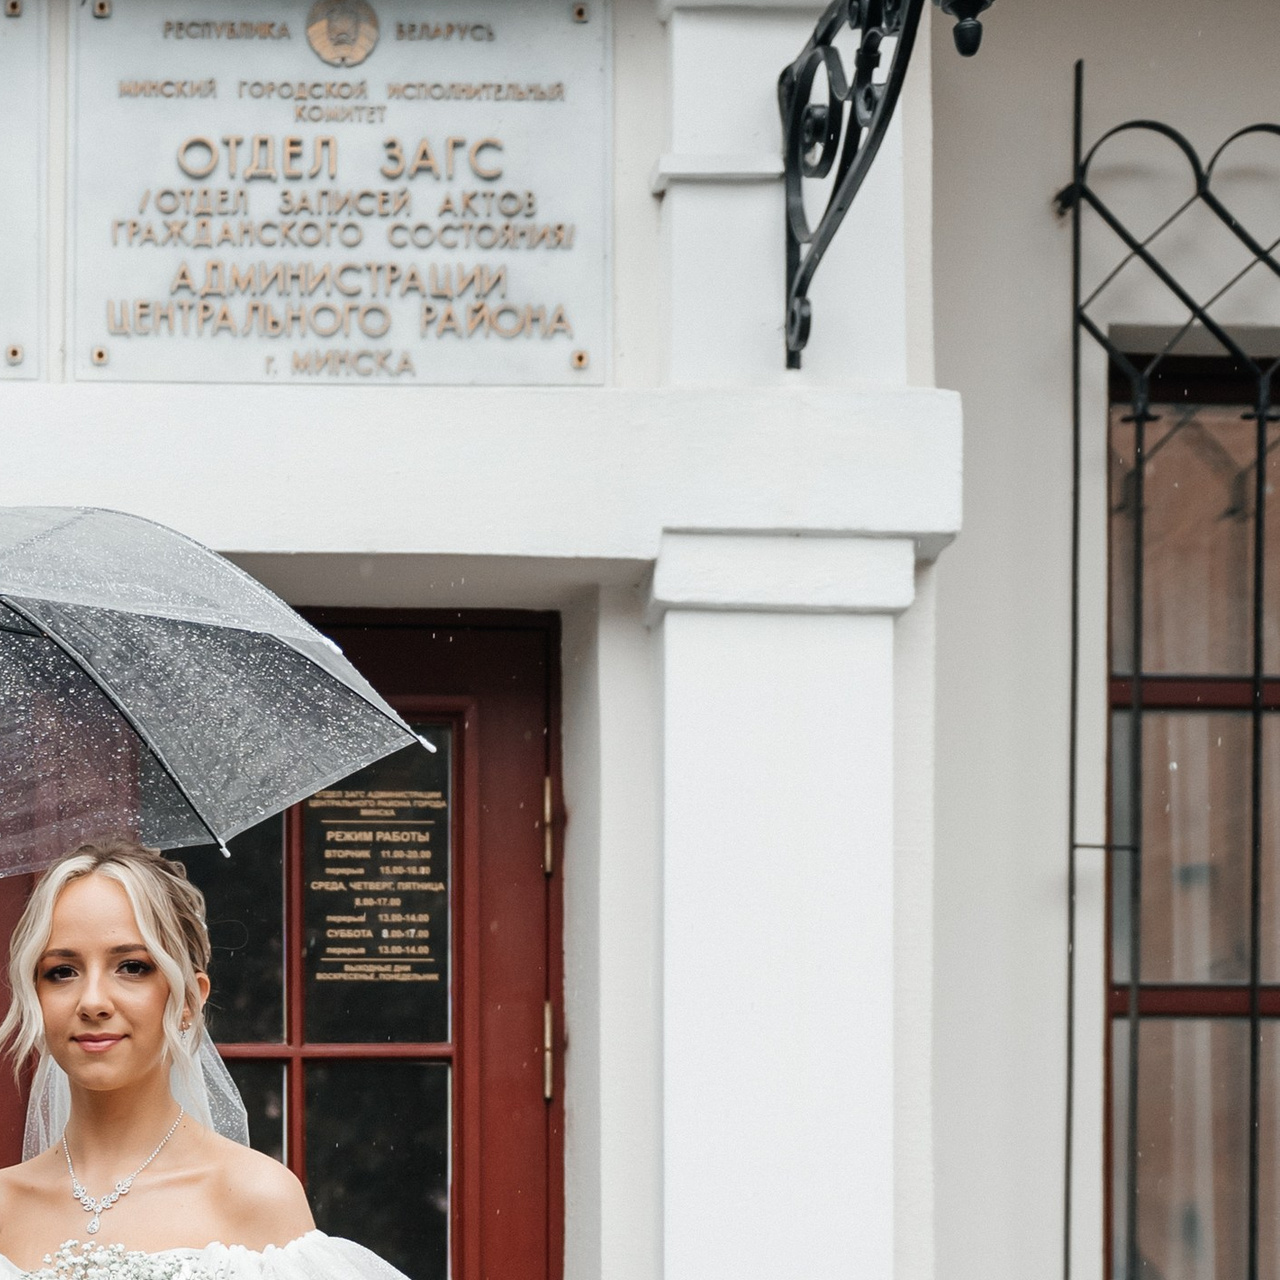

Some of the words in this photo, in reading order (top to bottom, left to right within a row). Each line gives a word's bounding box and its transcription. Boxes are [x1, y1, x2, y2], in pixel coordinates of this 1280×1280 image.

[163, 20, 291, 40] РЕСПУБЛИКА
[396, 22, 495, 42] БЕЛАРУСЬ
[119, 78, 216, 99] МИНСКИЙ
[238, 79, 368, 100] ГОРОДСКОЙ
[387, 81, 565, 102] ИСПОЛНИТЕЛЬНЫЙ
[294, 104, 387, 124] КОМИТЕТ
[177, 135, 338, 183] ОТДЕЛ
[379, 137, 505, 183] ЗАГС
[278, 187, 412, 218] ЗАПИСЕЙ
[438, 190, 539, 218] АКТОВ
[111, 219, 363, 249] ГРАЖДАНСКОГО
[169, 261, 508, 300] АДМИНИСТРАЦИИ
[106, 299, 392, 338] ЦЕНТРАЛЬНОГО
[420, 300, 574, 339] РАЙОНА
[291, 349, 416, 377] МИНСКА
[326, 831, 373, 842] РЕЖИМ
[376, 831, 430, 842] РАБОТЫ
[324, 850, 371, 859] ВТОРНИК
[397, 882, 446, 892] ПЯТНИЦА
[326, 929, 373, 938] СУББОТА
